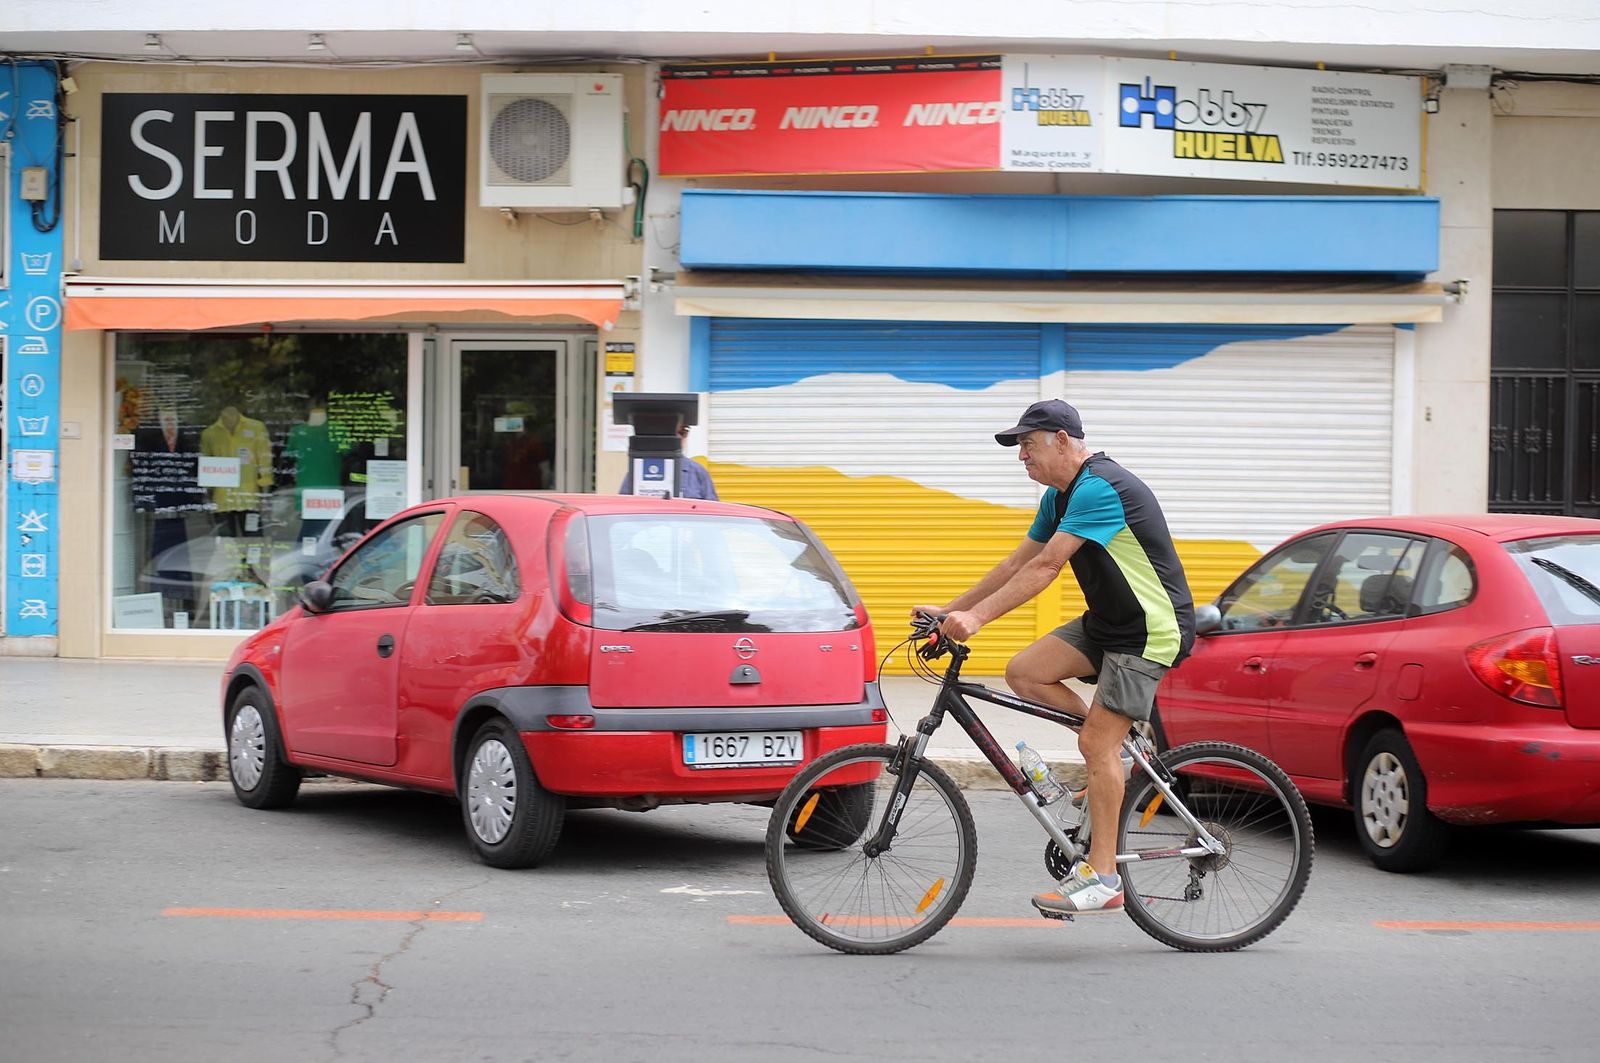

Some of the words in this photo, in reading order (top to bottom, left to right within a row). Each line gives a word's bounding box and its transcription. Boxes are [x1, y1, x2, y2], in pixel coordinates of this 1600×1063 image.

[661, 108, 756, 132] NINCO
[779, 105, 878, 130] NINCO
[903, 101, 1002, 127] NINCO
[127, 109, 437, 202] SERMA
[1011, 149, 1077, 158] Maquetas
[1174, 129, 1285, 164] HUELVA
[1011, 160, 1045, 168] Radio
[1048, 160, 1092, 168] Control
[1292, 151, 1409, 171] Tlf.959227473
[703, 735, 750, 758] 1667
[763, 734, 799, 758] BZV
